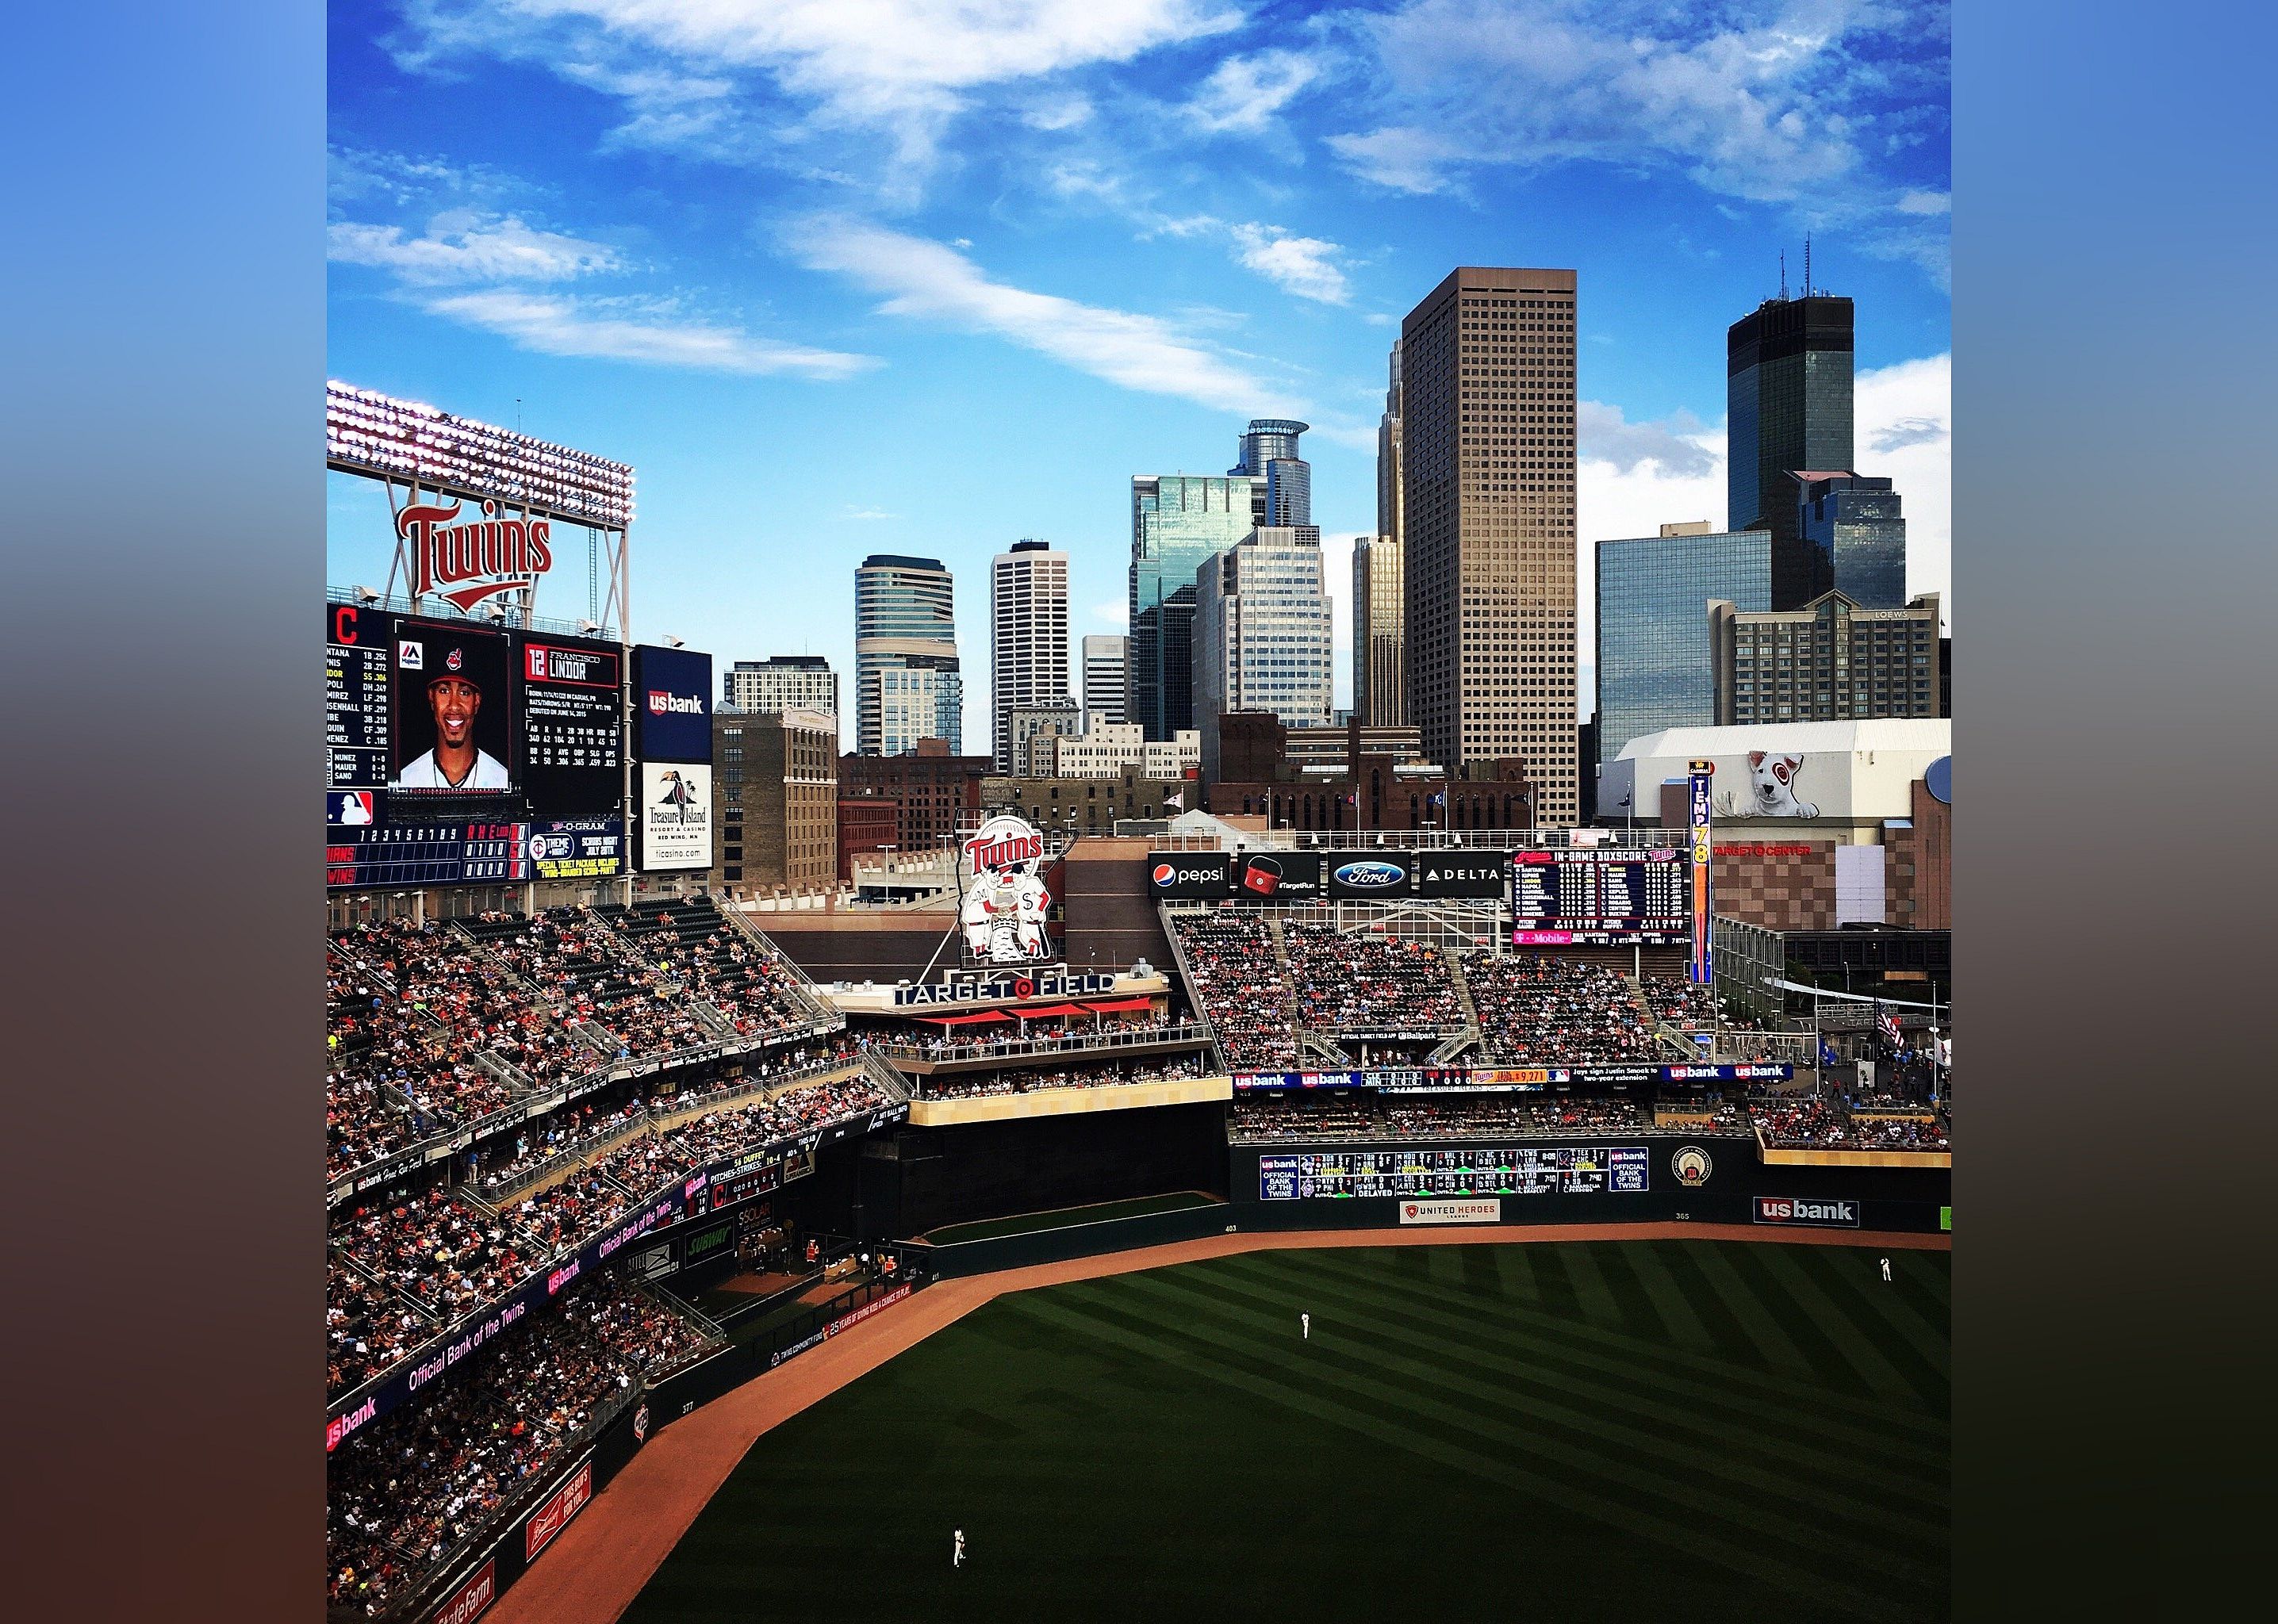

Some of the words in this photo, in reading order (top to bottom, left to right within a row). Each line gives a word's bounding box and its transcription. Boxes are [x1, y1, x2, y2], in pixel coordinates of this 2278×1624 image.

[397, 498, 552, 599] Twins
[1875, 611, 1908, 619] LOEWS
[337, 607, 357, 644] C
[529, 649, 545, 676] 12
[550, 651, 600, 664] FRANCISCO
[550, 659, 586, 680] LINDOR
[650, 692, 704, 714] usbank
[1693, 779, 1707, 827] TEMP
[650, 806, 679, 823] Treasure
[686, 806, 706, 823] Island
[361, 830, 365, 841] 1
[371, 830, 378, 841] 2
[382, 830, 389, 841] 3
[395, 829, 401, 841] 4
[406, 829, 412, 841] 5
[417, 829, 424, 841] 6
[439, 829, 446, 840] 8
[451, 829, 456, 840] 9
[546, 837, 570, 849] THEME
[586, 846, 600, 856] JULY
[655, 849, 700, 858] ticasino.com
[1693, 827, 1708, 864] 78
[1766, 846, 1812, 856] CENTER
[965, 832, 1041, 876] Twins
[1555, 852, 1595, 862] IN-GAME
[1597, 851, 1647, 862] BOXSCORE
[1648, 850, 1676, 862] Twins
[536, 861, 557, 870] SPECIAL
[558, 860, 575, 869] TICKET
[576, 859, 596, 868] PACKAGE
[1178, 867, 1224, 883] pepsi
[1348, 865, 1390, 883] Ford
[1444, 869, 1499, 880] DELTA
[976, 890, 989, 902] M
[1022, 891, 1034, 910] S
[898, 979, 1011, 1005] TARGET
[1040, 975, 1116, 995] FIELD
[1406, 1032, 1436, 1040] Ballpark
[1302, 1073, 1352, 1085] usbank
[1473, 1071, 1494, 1082] Twins
[1670, 1066, 1720, 1078] usbank
[1735, 1065, 1784, 1077] usbank
[1235, 1074, 1286, 1086] usbank
[887, 1107, 898, 1117] BALL
[872, 1120, 884, 1130] SPEED
[798, 1136, 808, 1147] THIS
[808, 1134, 816, 1143] AB
[734, 1158, 742, 1167] 56
[743, 1150, 765, 1164] DUFFEY
[1262, 1159, 1298, 1169] usbank
[1612, 1151, 1647, 1161] usbank
[710, 1161, 762, 1184] PITCHES-STRIKES:
[766, 1153, 780, 1166] 10-4
[358, 1172, 382, 1191] usbank
[714, 1184, 724, 1208] C
[1420, 1206, 1455, 1215] UNITED
[1458, 1205, 1495, 1214] HEROES
[1762, 1200, 1854, 1221] usbank
[548, 1258, 581, 1294] usbank
[599, 1231, 622, 1258] Official
[623, 1222, 638, 1243] Bank
[639, 1216, 646, 1231] of
[646, 1210, 656, 1226] the
[656, 1200, 672, 1219] Twins
[687, 1228, 729, 1257] SUBWAY
[830, 1320, 839, 1335] 25
[839, 1316, 852, 1330] YEARS
[851, 1313, 857, 1323] OF
[857, 1307, 869, 1320] GIVING
[869, 1300, 878, 1314] KIDS
[882, 1293, 896, 1308] CHANCE
[895, 1290, 901, 1300] TO
[408, 1351, 446, 1392] Official
[447, 1335, 472, 1366] Bank
[474, 1327, 484, 1346] of
[485, 1320, 500, 1339] the
[501, 1300, 525, 1327] Twins
[780, 1347, 792, 1360] TWINS
[792, 1337, 813, 1354] COMMUNITY
[813, 1331, 823, 1343] FUND
[682, 1400, 694, 1414] 377
[563, 1483, 574, 1503] THIS
[574, 1469, 588, 1492] BUD'S
[563, 1499, 573, 1519] FOR
